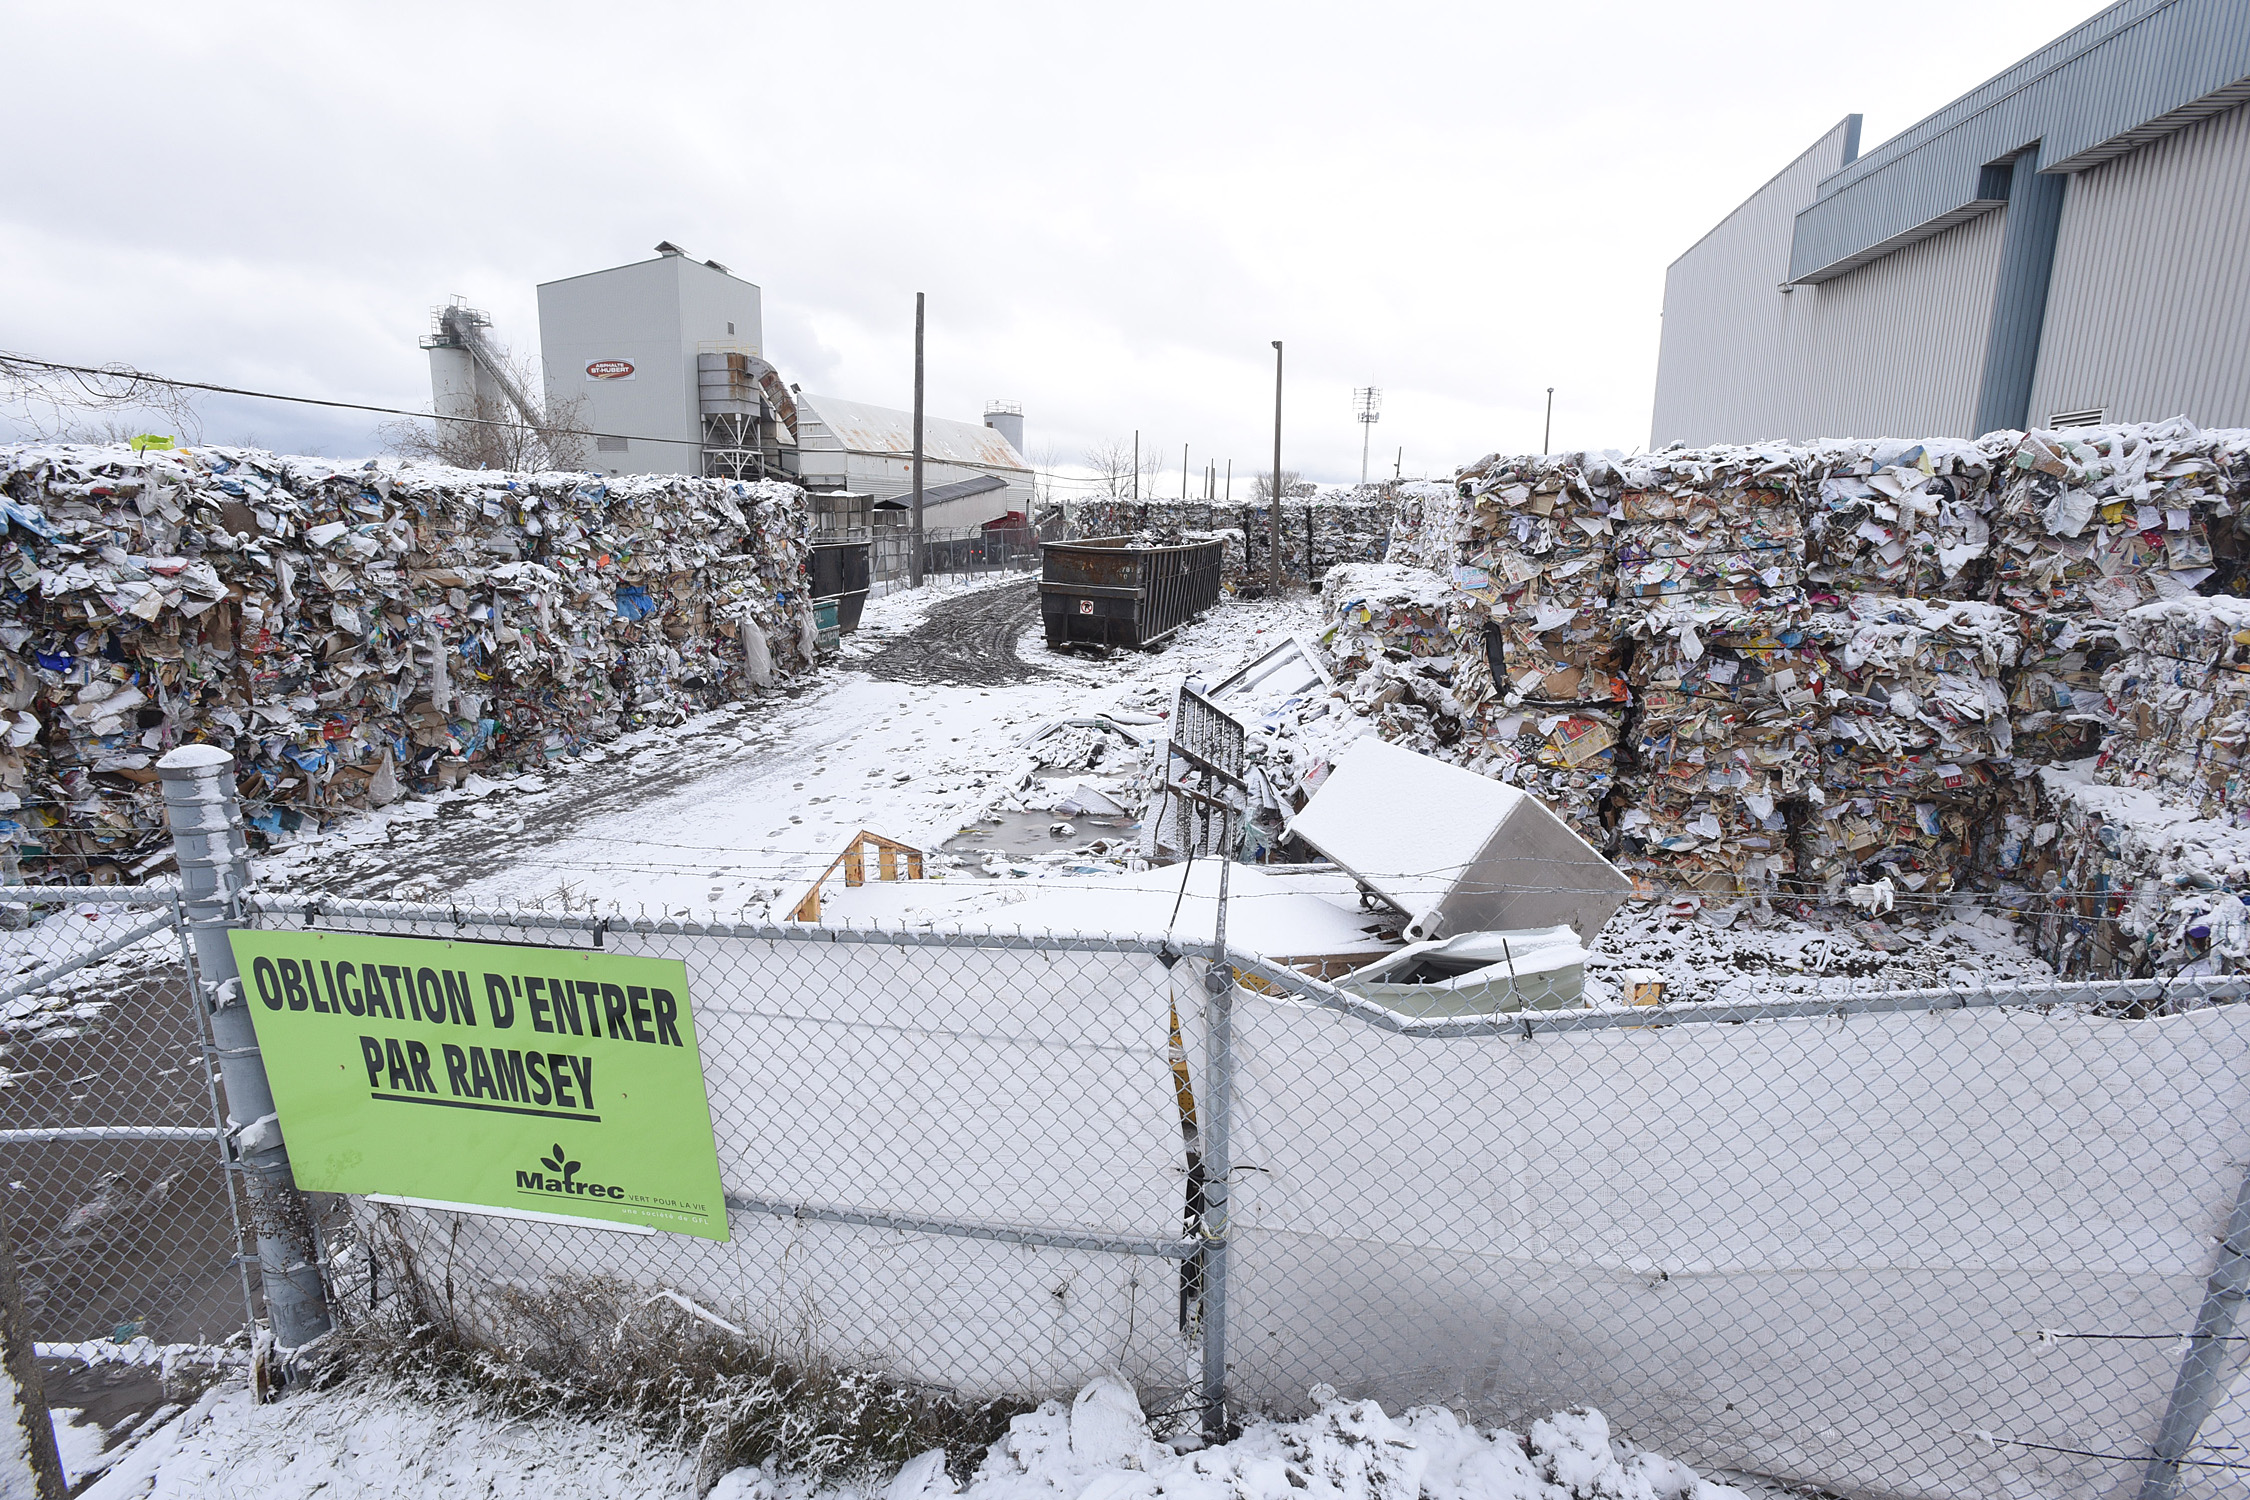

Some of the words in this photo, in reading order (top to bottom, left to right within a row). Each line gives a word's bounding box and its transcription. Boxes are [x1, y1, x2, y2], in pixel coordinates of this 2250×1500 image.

[253, 956, 477, 1026] OBLIGATION
[483, 973, 684, 1047] D'ENTRER
[359, 1035, 438, 1094] PAR
[441, 1043, 594, 1110] RAMSEY
[516, 1161, 625, 1199] Matrec
[628, 1194, 650, 1203] VERT
[653, 1197, 677, 1207] POUR
[679, 1201, 692, 1209] LA
[692, 1203, 707, 1212] VIE
[641, 1210, 674, 1220] société
[677, 1214, 689, 1222] de
[691, 1216, 709, 1225] GFL
